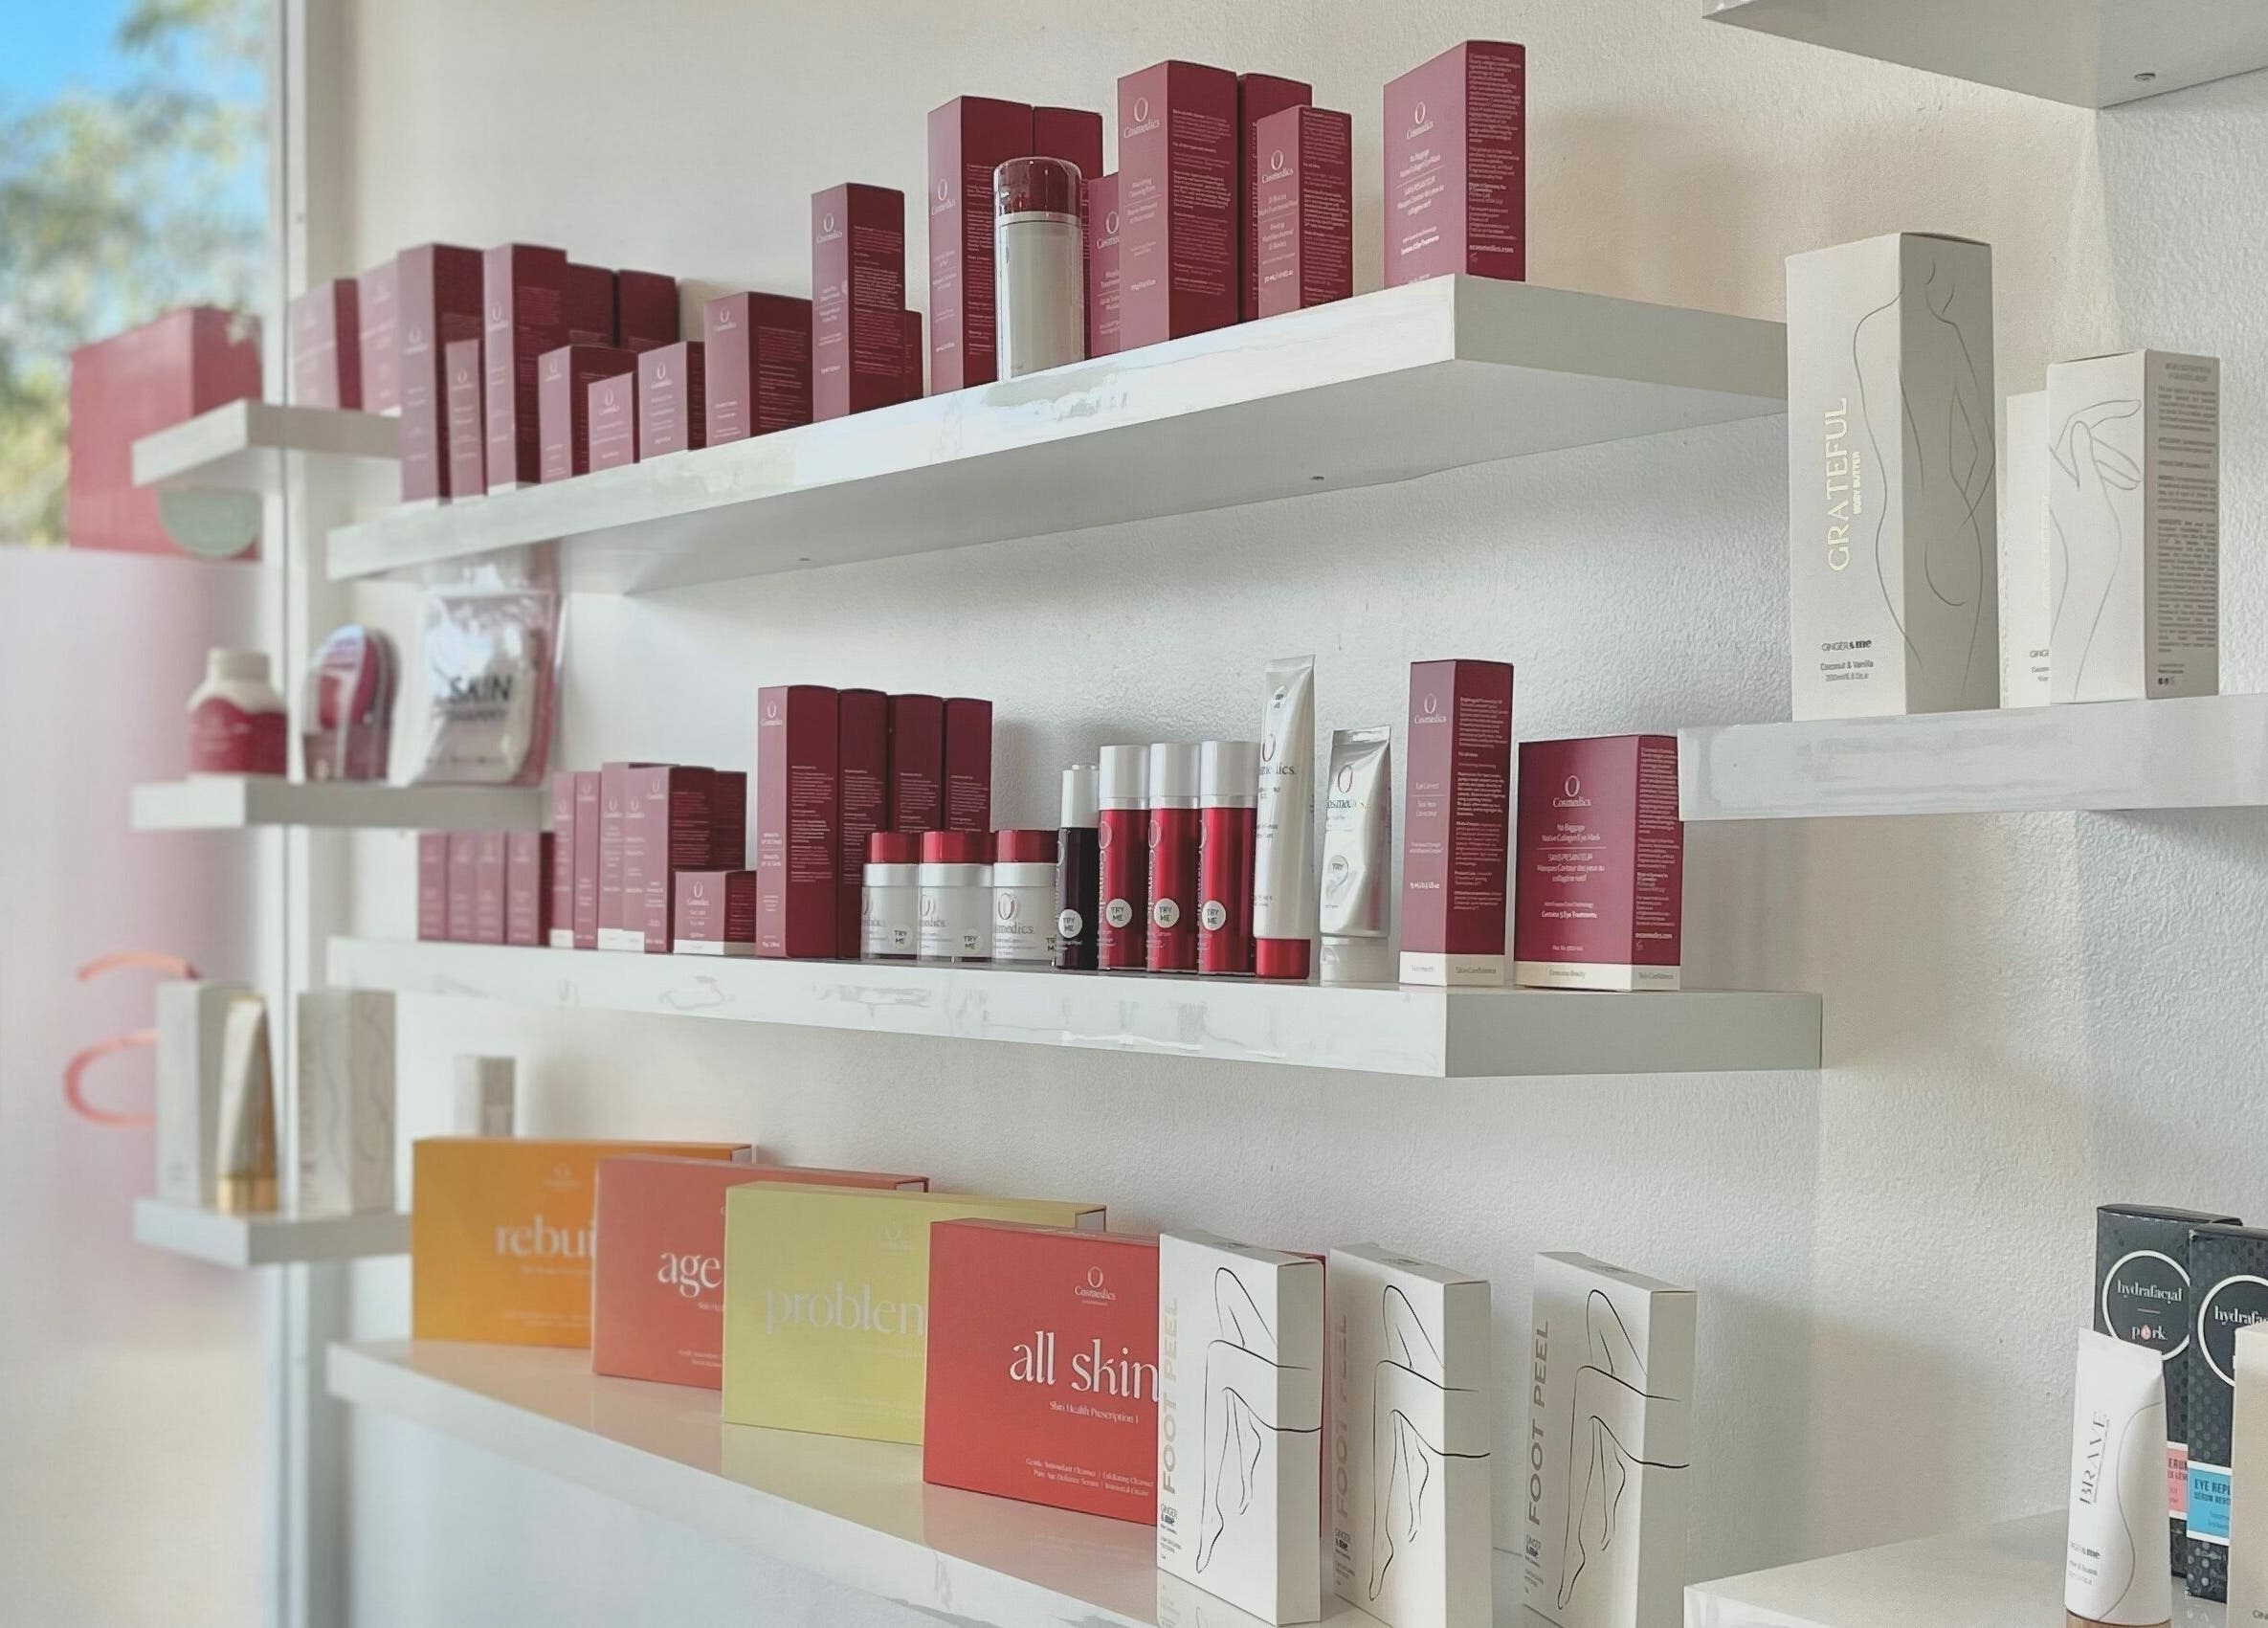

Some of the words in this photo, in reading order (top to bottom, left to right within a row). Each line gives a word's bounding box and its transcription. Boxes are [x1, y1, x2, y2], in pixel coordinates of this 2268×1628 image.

[1824, 397, 1850, 571] GRATEFUL
[1553, 796, 1591, 808] Cosmedics
[1565, 775, 1581, 797] O
[657, 1251, 723, 1298] age
[1074, 1285, 1117, 1301] Cosmedics
[1087, 1266, 1103, 1288] O
[2117, 1279, 2183, 1304] hydrafacial
[1010, 1330, 1056, 1386] all
[1071, 1338, 1158, 1403] skin
[1164, 1298, 1179, 1382] PEEL
[1533, 1321, 1548, 1408] PEEL
[1163, 1393, 1176, 1495] FOOT
[1336, 1415, 1348, 1518] FOOT
[1528, 1418, 1545, 1526] FOOT
[2079, 1411, 2106, 1505] BRAVE
[2194, 1479, 2211, 1492] EYE
